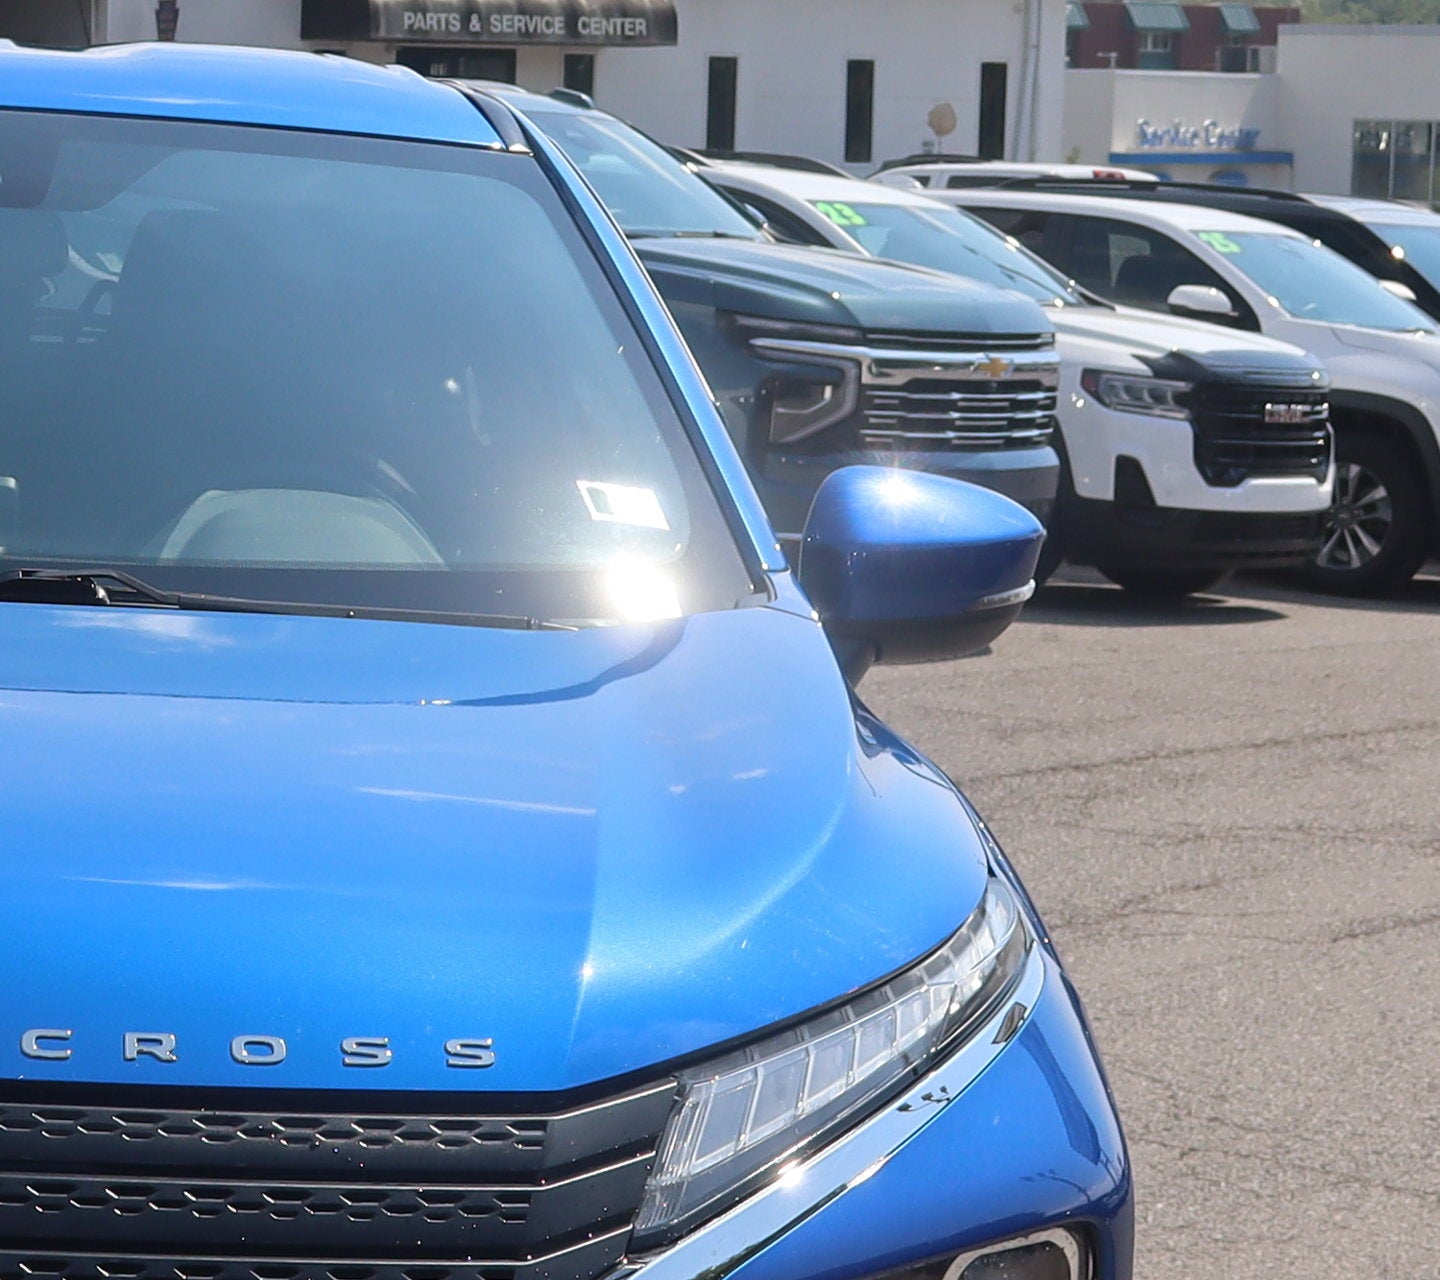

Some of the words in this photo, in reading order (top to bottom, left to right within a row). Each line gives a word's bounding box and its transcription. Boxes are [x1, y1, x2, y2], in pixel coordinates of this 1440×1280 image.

[403, 11, 462, 32] PARTS
[469, 14, 482, 34] &
[489, 14, 565, 35] SERVICE
[577, 16, 648, 37] CENTER
[20, 1028, 497, 1069] CROSS
